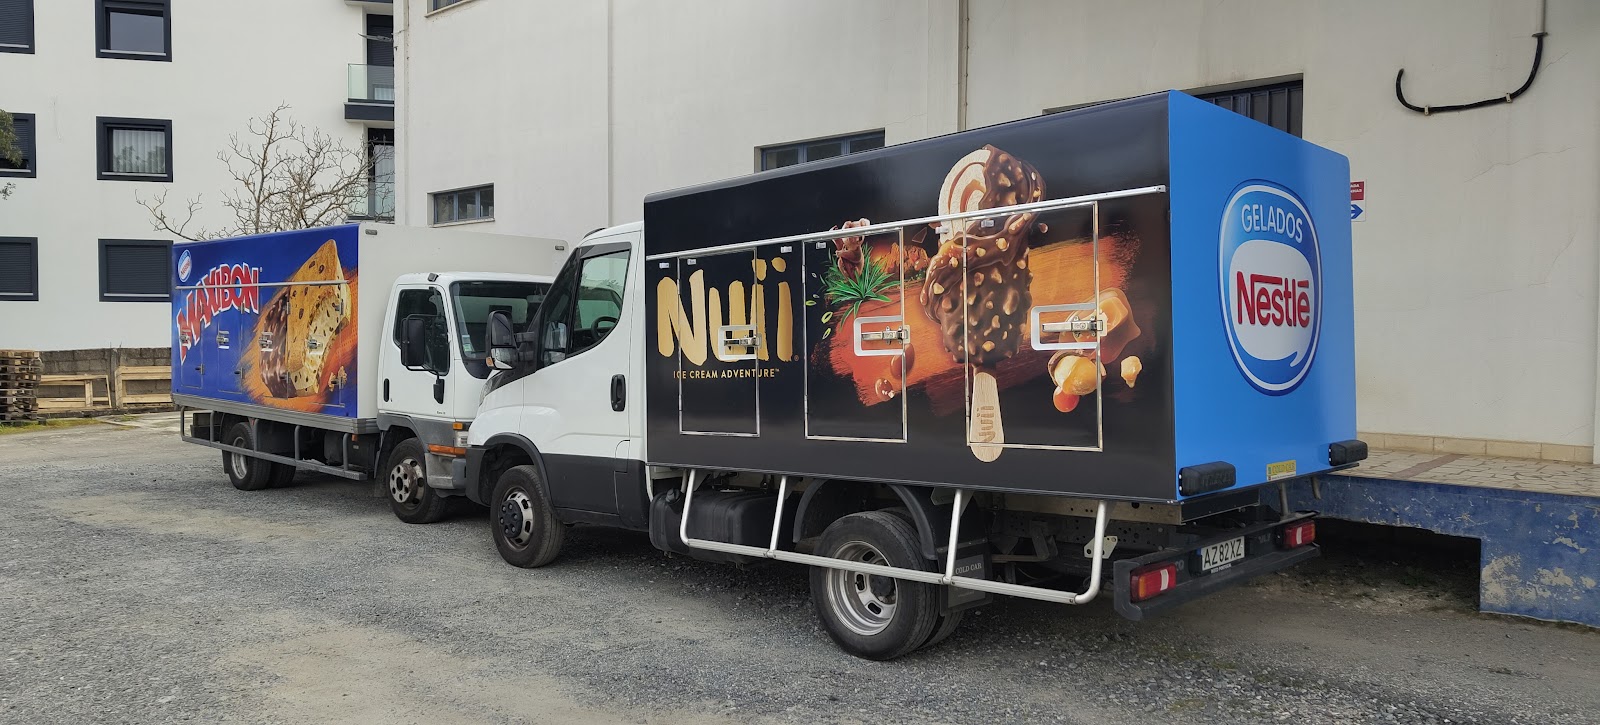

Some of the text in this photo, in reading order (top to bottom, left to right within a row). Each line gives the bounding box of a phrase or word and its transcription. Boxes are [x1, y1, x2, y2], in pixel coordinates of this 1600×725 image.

[1241, 204, 1303, 244] GELADOS
[176, 262, 259, 366] MAXIBON
[657, 256, 793, 366] Nuii
[1236, 271, 1310, 328] Nestlé
[673, 370, 687, 379] ICE
[689, 369, 718, 379] CREAM
[955, 562, 982, 575] COLD CAR
